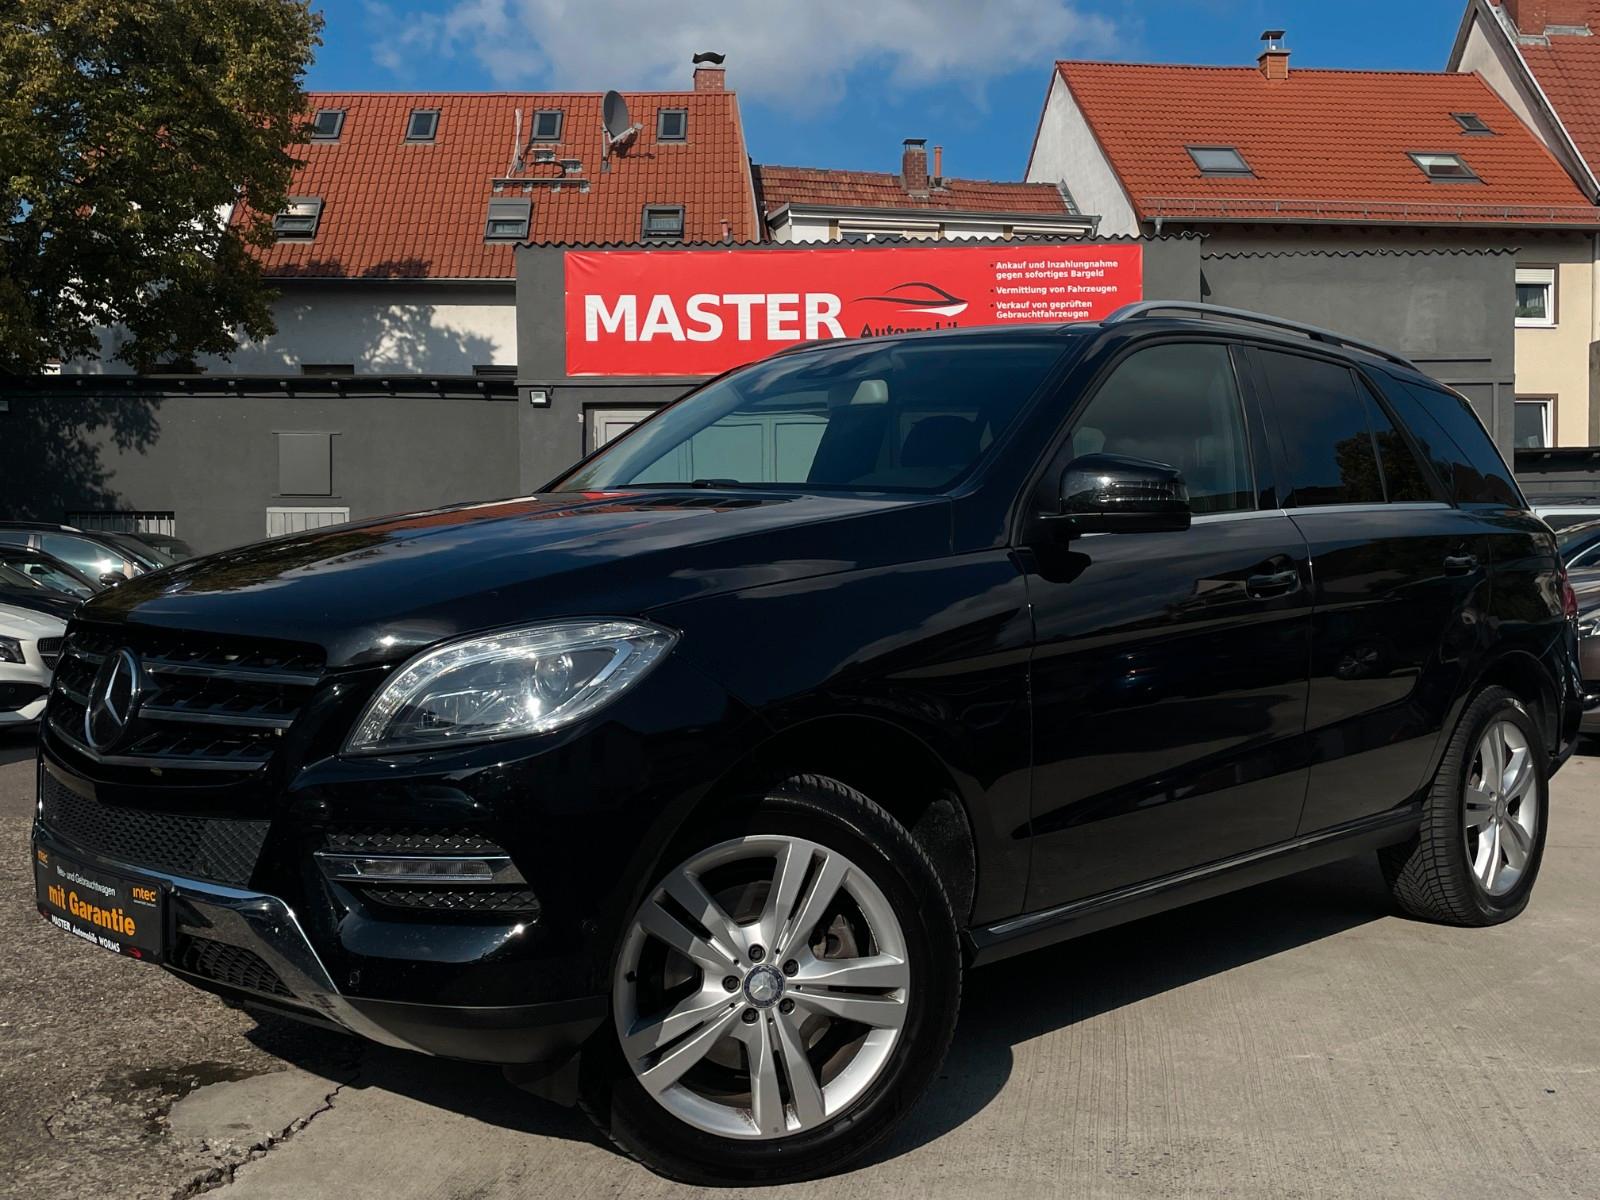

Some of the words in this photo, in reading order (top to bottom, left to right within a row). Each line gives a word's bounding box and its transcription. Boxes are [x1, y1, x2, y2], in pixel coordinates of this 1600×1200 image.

[996, 261, 1027, 270] Ankauf
[1029, 261, 1045, 269] und
[1047, 260, 1119, 270] Inzahlungnahme
[996, 272, 1023, 281] gegen
[1025, 270, 1069, 280] sofortiges
[1071, 269, 1105, 279] Bargeld
[996, 286, 1047, 295] Vermittlung
[1067, 285, 1118, 294] Fahrzeugen
[996, 301, 1030, 309] Verkauf
[1050, 300, 1093, 310] geprüften
[584, 293, 847, 343] MASTER
[996, 310, 1089, 319] Gebrauchtfahrzeugen
[48, 884, 66, 910] mit
[68, 890, 136, 936] Garantie
[51, 914, 71, 931] MASTER
[98, 935, 121, 953] WORMS
